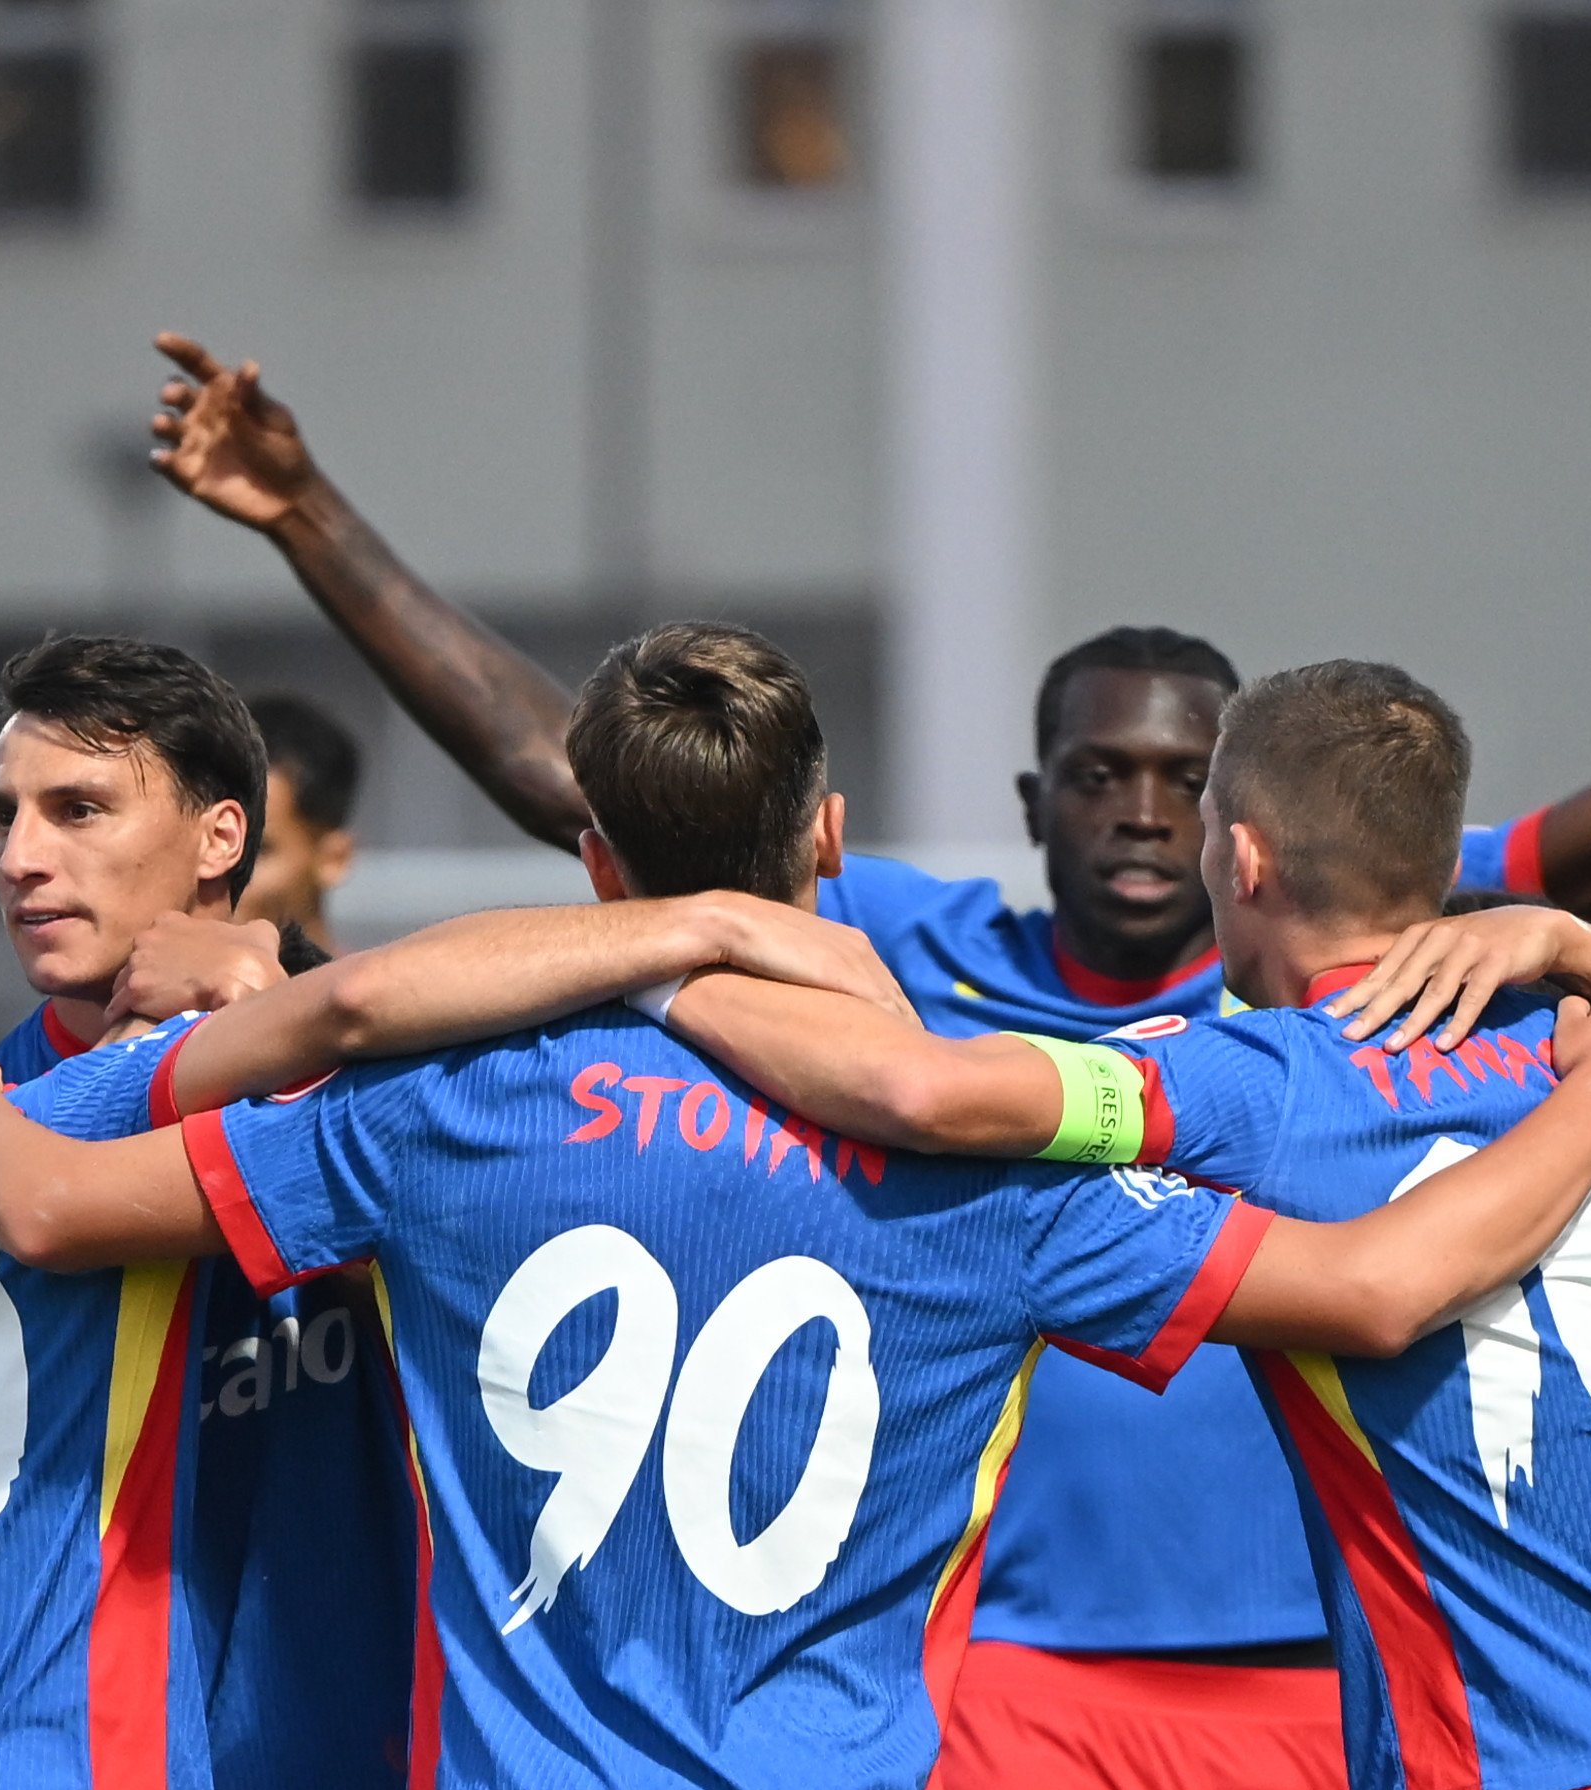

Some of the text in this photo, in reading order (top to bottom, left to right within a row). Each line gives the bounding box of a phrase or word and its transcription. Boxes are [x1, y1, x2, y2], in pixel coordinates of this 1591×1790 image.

[562, 1061, 887, 1185] STOIAN
[1348, 1032, 1562, 1113] TANA
[1076, 1086, 1118, 1163] RESPEC
[477, 1223, 881, 1637] 90
